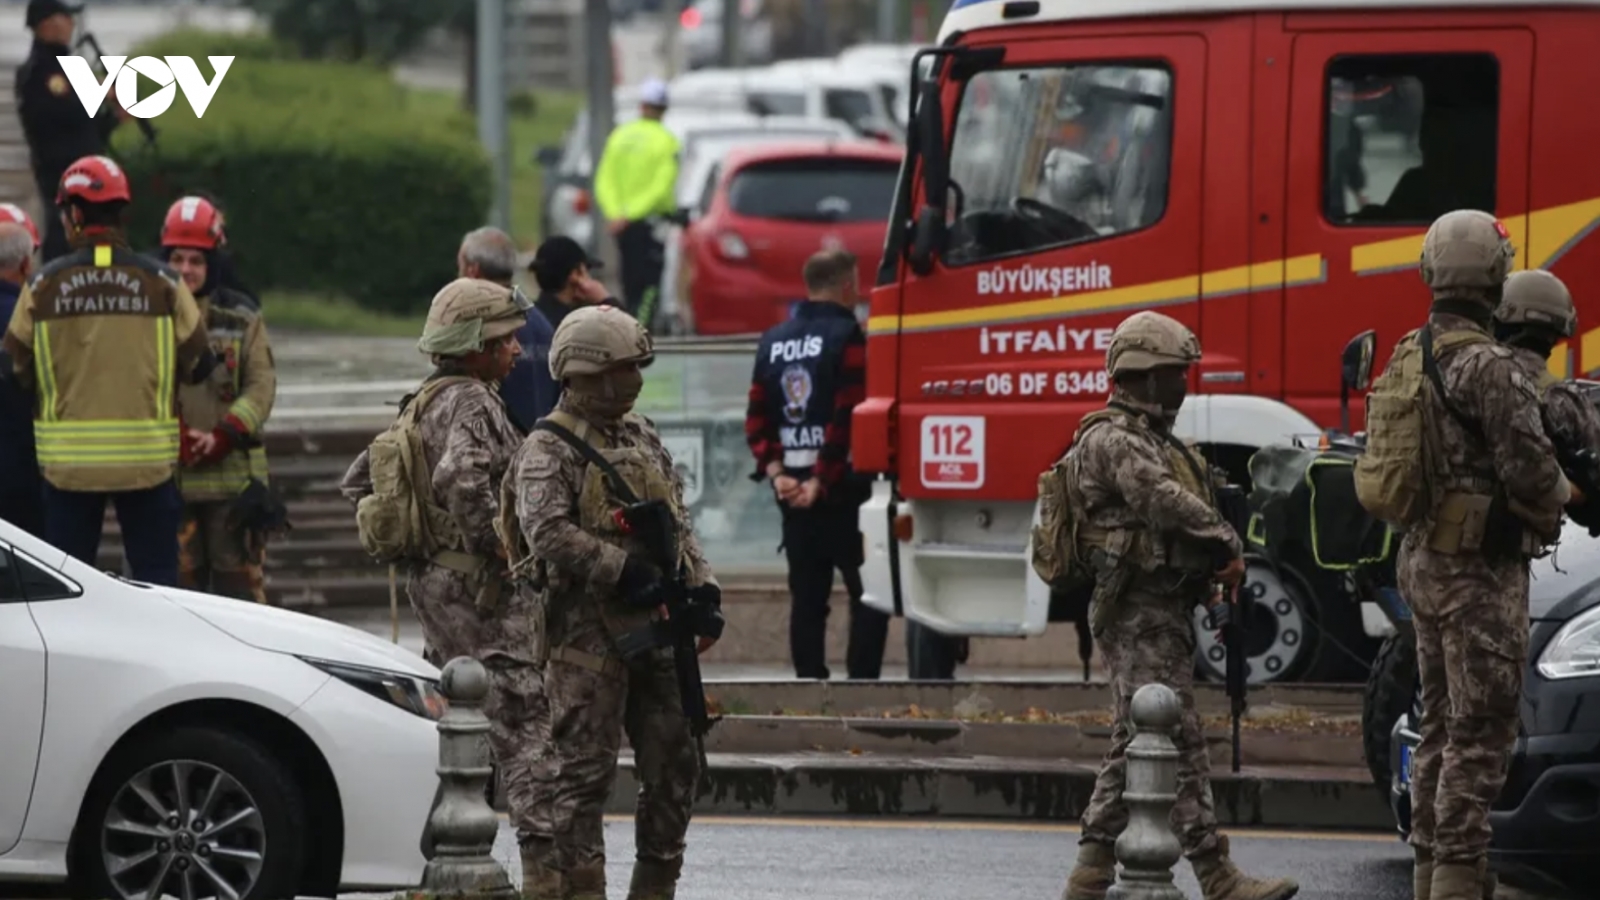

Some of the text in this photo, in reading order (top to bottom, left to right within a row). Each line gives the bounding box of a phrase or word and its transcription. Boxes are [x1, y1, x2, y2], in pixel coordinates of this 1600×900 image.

[60, 269, 141, 297] ANKARA
[977, 260, 1112, 297] BÜYÜKŞEHİR
[770, 335, 823, 364] POLİS
[980, 325, 1114, 354] İTFAİYE
[985, 370, 1109, 396] 06 DF 6348
[930, 424, 973, 456] 112
